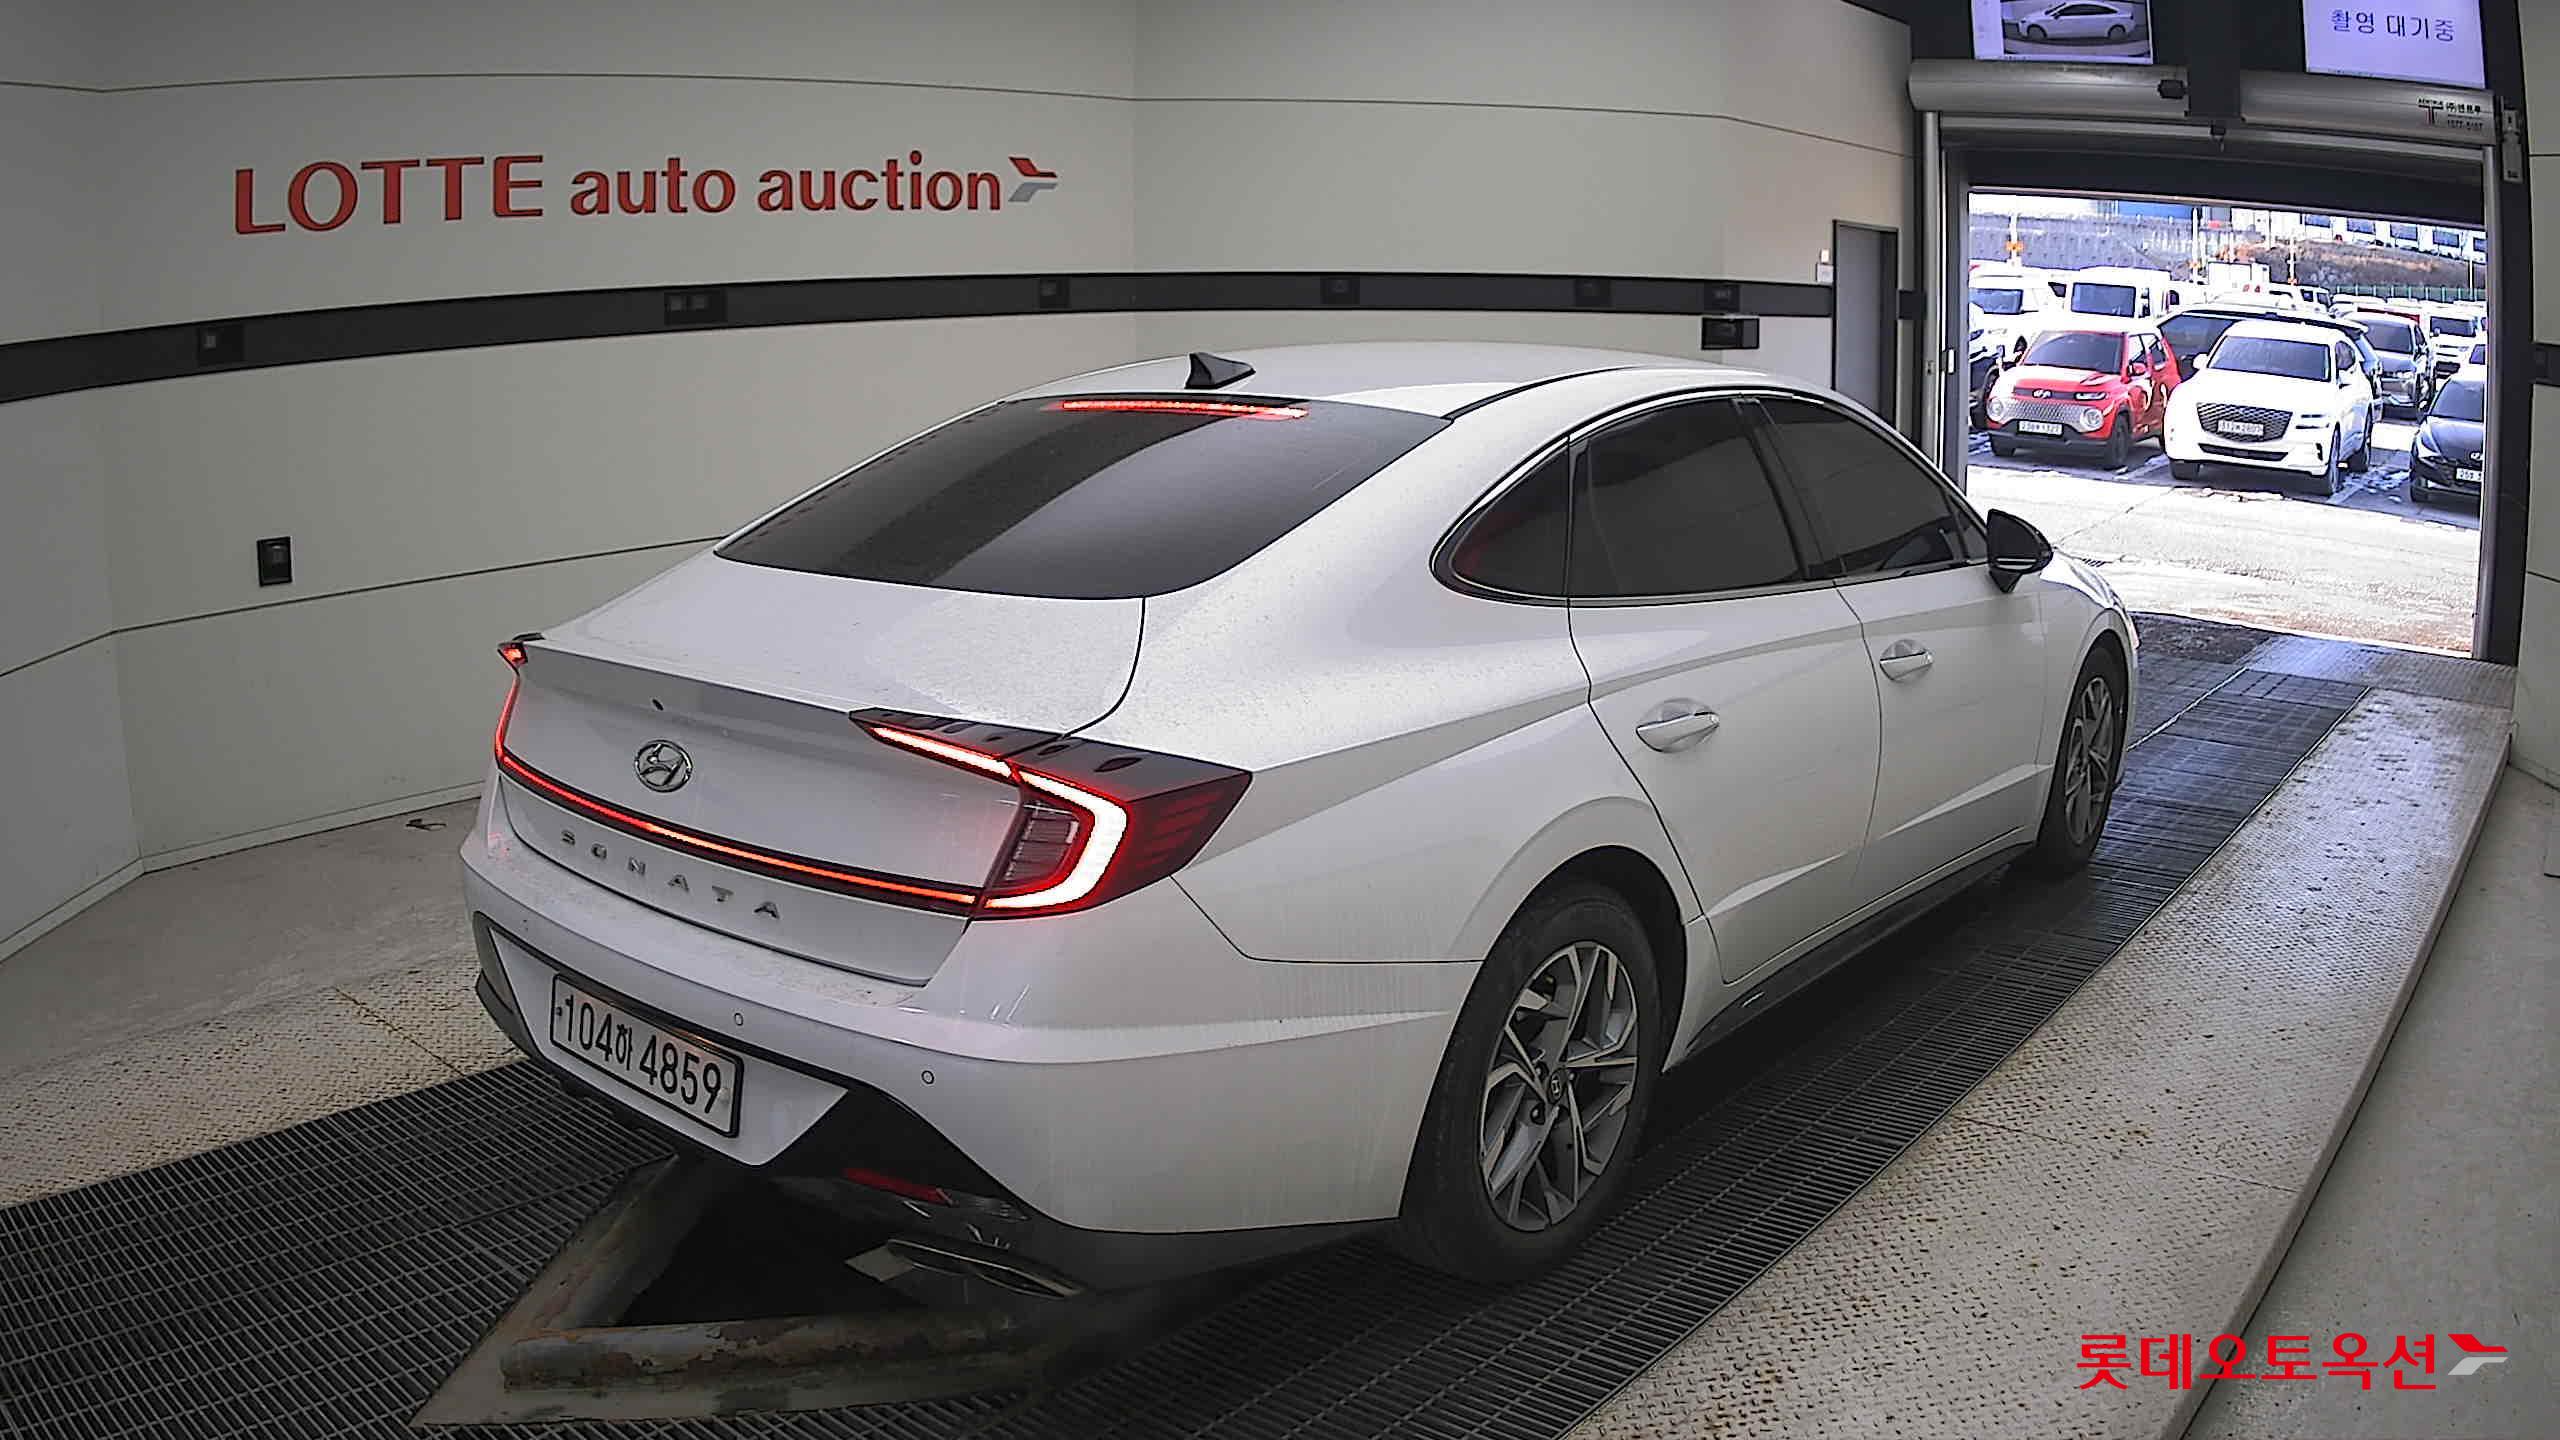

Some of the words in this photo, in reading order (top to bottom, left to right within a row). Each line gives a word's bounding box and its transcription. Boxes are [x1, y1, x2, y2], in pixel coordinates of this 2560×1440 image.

[2331, 9, 2375, 34] 촬영
[2386, 15, 2455, 42] 대기중
[235, 154, 544, 234] LOTTE
[570, 156, 737, 216] auto
[757, 150, 1001, 213] auction
[560, 829, 782, 920] SONATA
[639, 1035, 722, 1114] 4859
